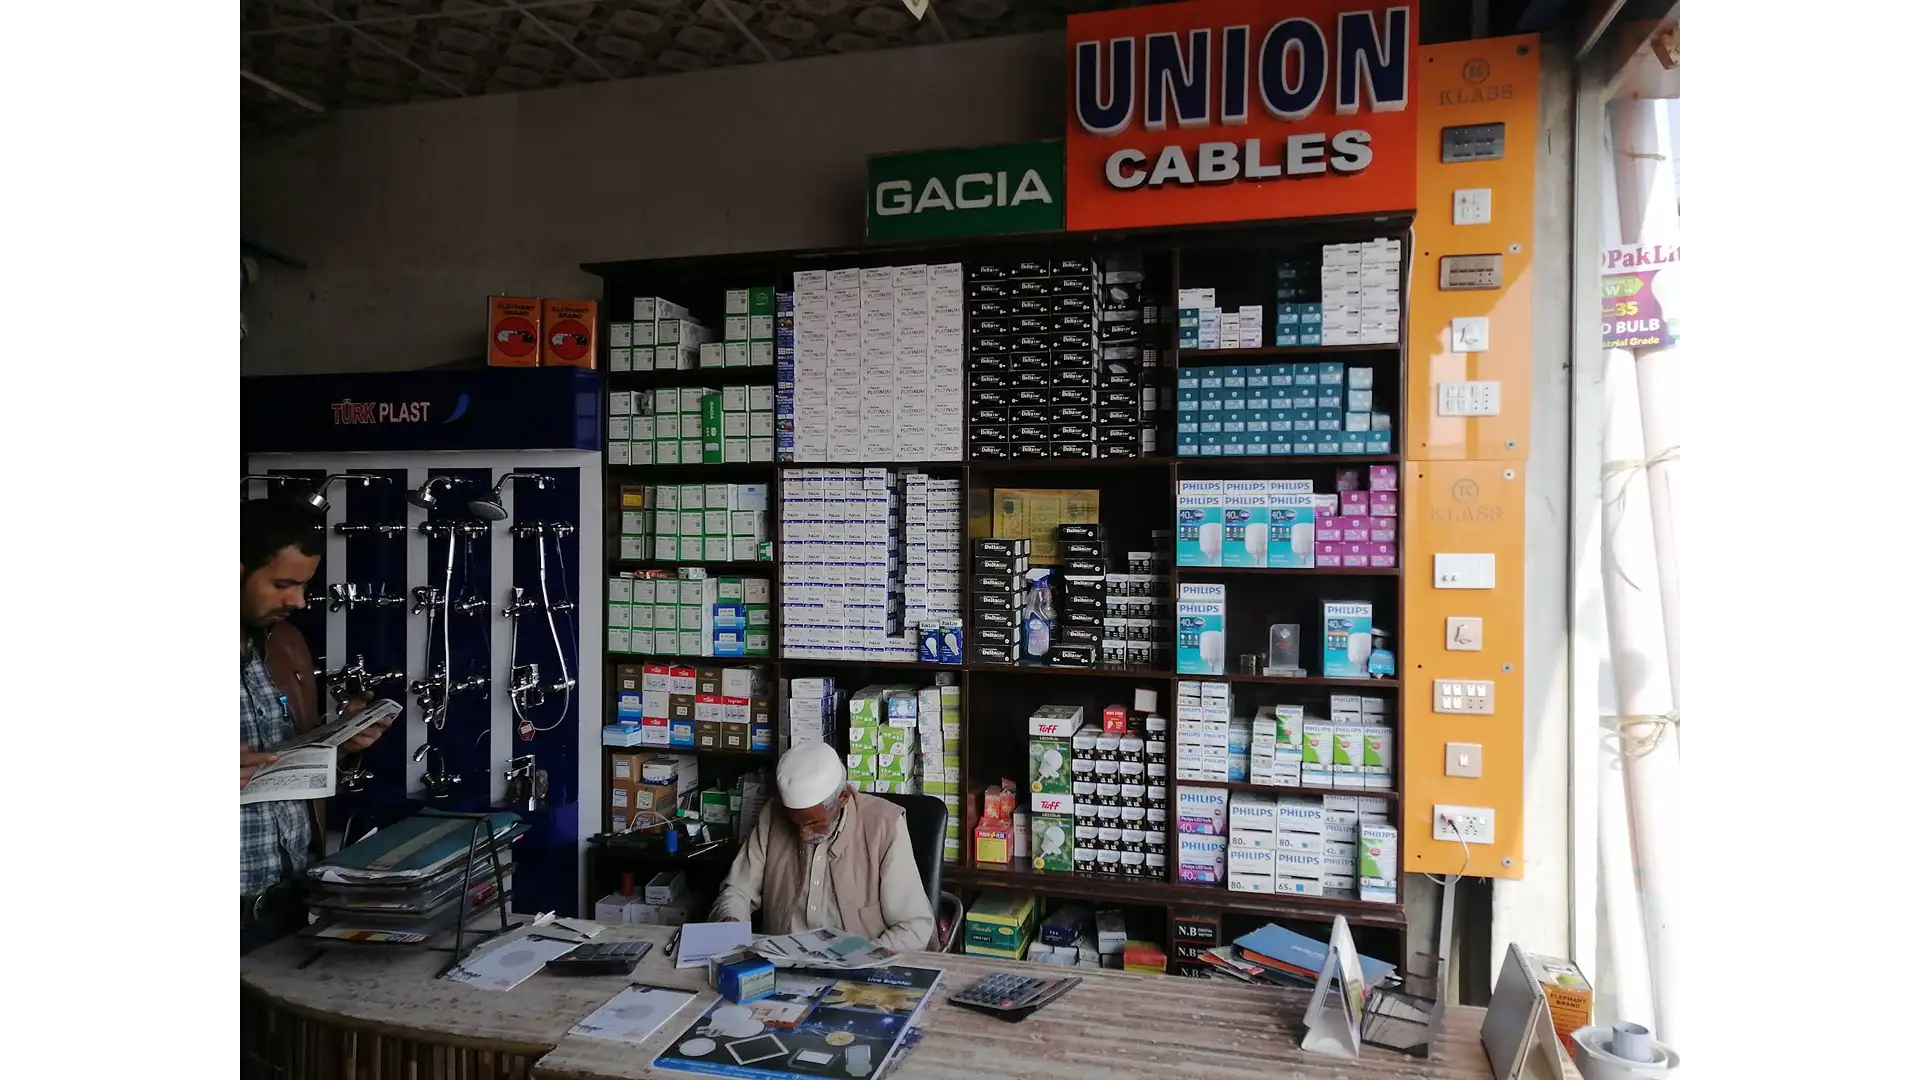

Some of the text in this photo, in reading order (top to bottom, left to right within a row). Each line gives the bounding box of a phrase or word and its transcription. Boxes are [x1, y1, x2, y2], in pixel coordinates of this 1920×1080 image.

[1075, 6, 1410, 138] UNION
[1437, 84, 1514, 106] KLASS
[1105, 129, 1374, 189] CABLES
[876, 168, 1053, 216] GACIA
[498, 302, 536, 311] ELEPHANT
[503, 309, 530, 317] BRAND
[1616, 319, 1660, 334] BULB
[1629, 337, 1660, 347] Grade
[331, 399, 431, 425] TÜRK PLAST
[1183, 483, 1221, 491] PHILIPS
[1227, 483, 1265, 491] PHILIPS
[1271, 482, 1310, 490] PHILIPS
[1180, 497, 1219, 505] PHILIPS
[1225, 496, 1265, 505] PHILIPS
[1271, 496, 1311, 505] PHILIPS
[1431, 505, 1502, 522] KLASS
[1183, 586, 1221, 595] PHILIPS
[1180, 604, 1219, 613] PHILIPS
[1328, 606, 1369, 615] PHILIPS
[1180, 793, 1223, 805] PHILIPS
[1232, 806, 1273, 817] PHILIPS
[1279, 808, 1321, 819] PHILIPS
[1325, 825, 1356, 833] PHILIPS
[1363, 830, 1396, 839] PHILIPS
[1181, 841, 1225, 853] PHILIPS
[1231, 851, 1272, 861] PHILIPS
[1279, 855, 1320, 865] PHILIPS
[1324, 858, 1354, 866] PHILIPS
[1178, 925, 1198, 937] N.B
[1178, 946, 1197, 957] N.B
[884, 978, 913, 986] Brighter
[1550, 994, 1587, 1004] ELEPHANT
[1556, 1001, 1580, 1009] BRAND
